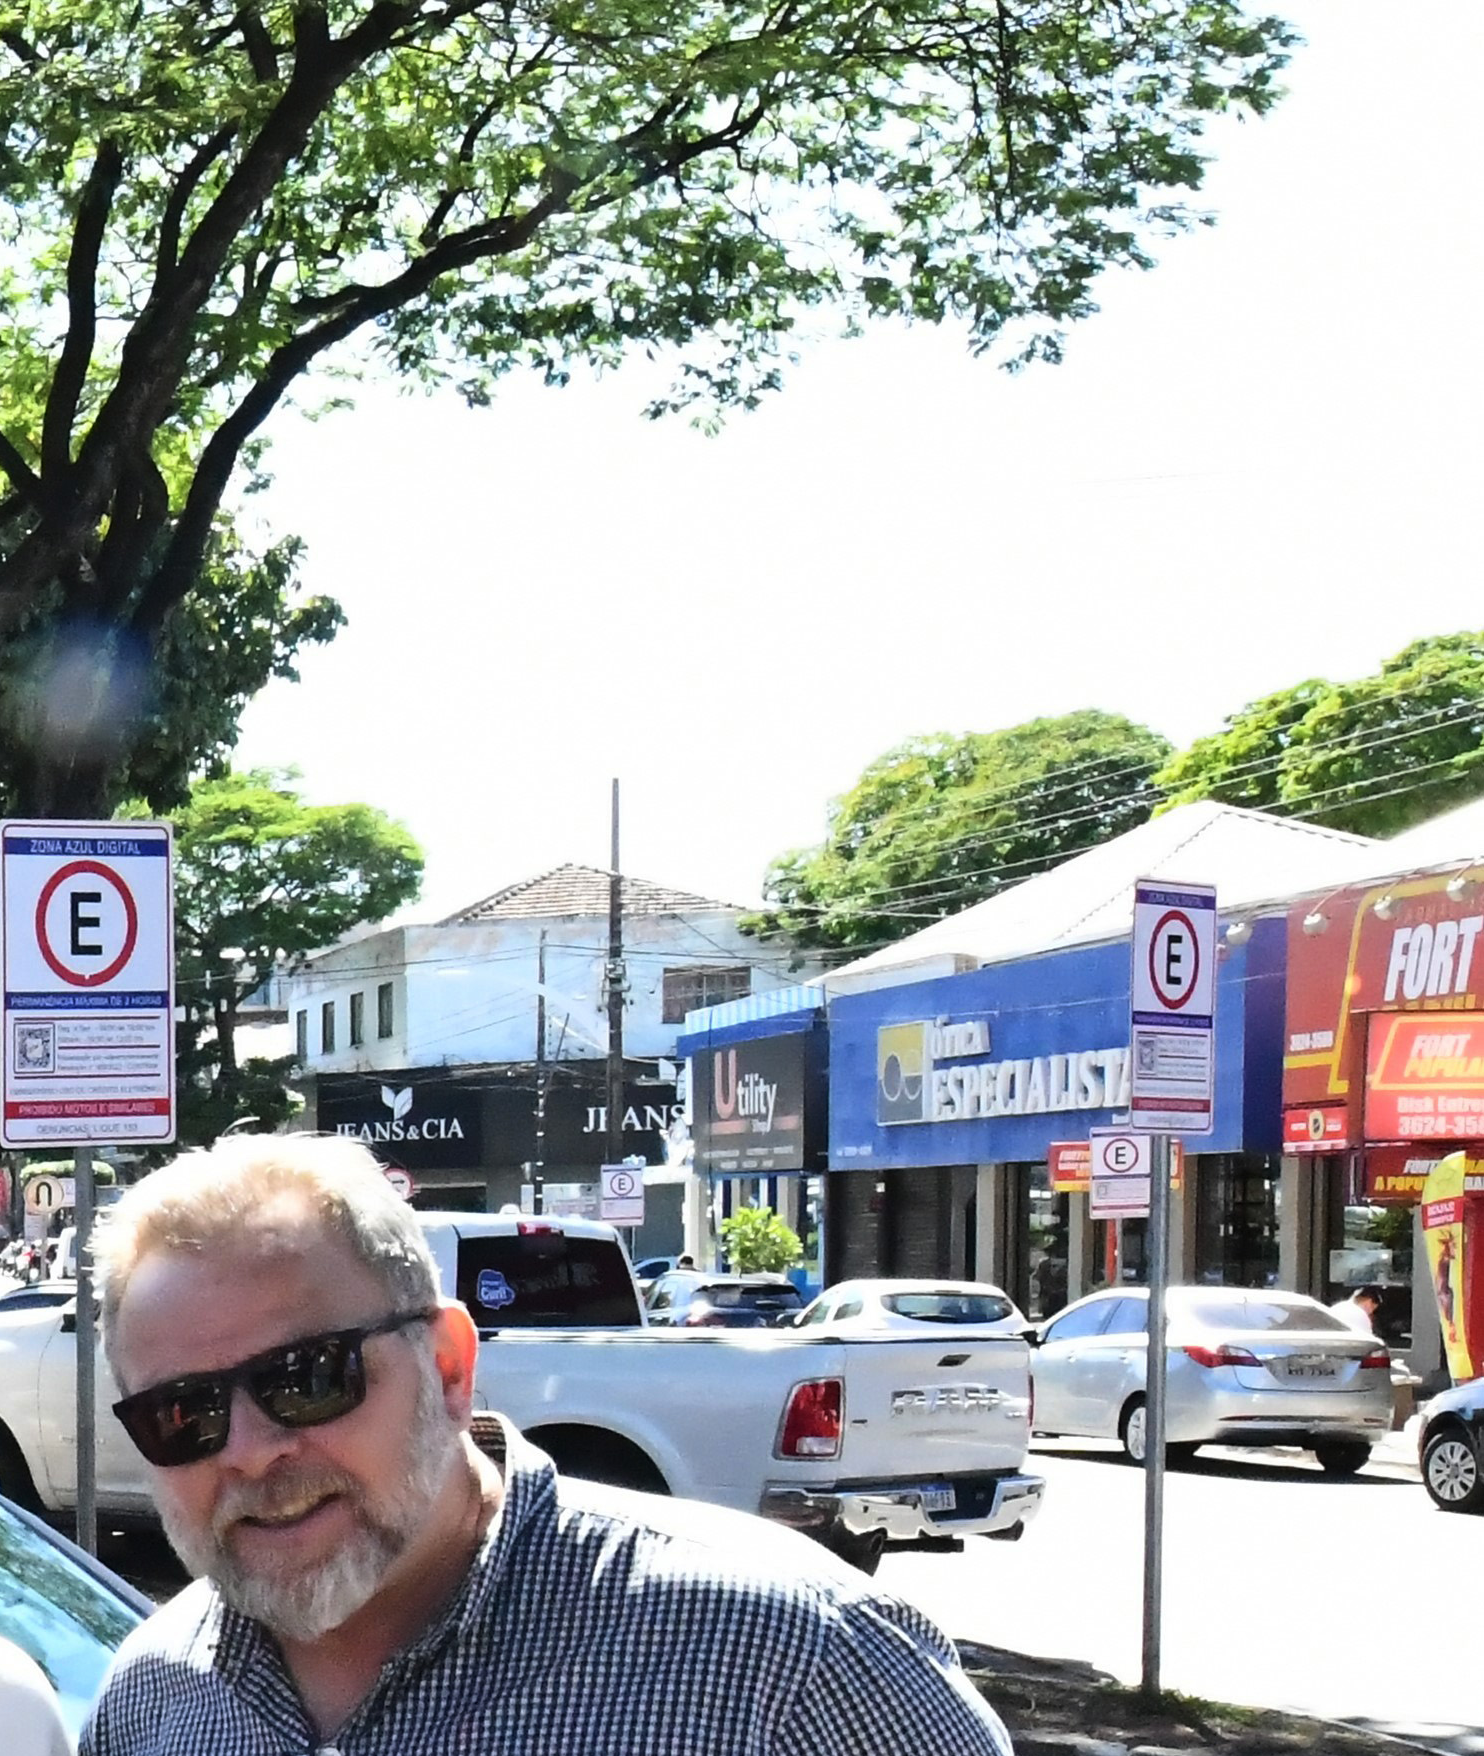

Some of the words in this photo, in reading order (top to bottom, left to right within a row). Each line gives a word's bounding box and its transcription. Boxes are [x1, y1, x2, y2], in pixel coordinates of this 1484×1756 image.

[30, 840, 62, 853] ZONA
[64, 840, 94, 854] AZUL
[97, 841, 141, 855] DIGITAL
[70, 892, 103, 955] E
[1166, 934, 1183, 986] E
[1384, 915, 1484, 1001] FORT
[1404, 1057, 1484, 1077] POPULA
[714, 1049, 777, 1132] Utility
[1114, 1146, 1127, 1165] E
[618, 1178, 627, 1191] E
